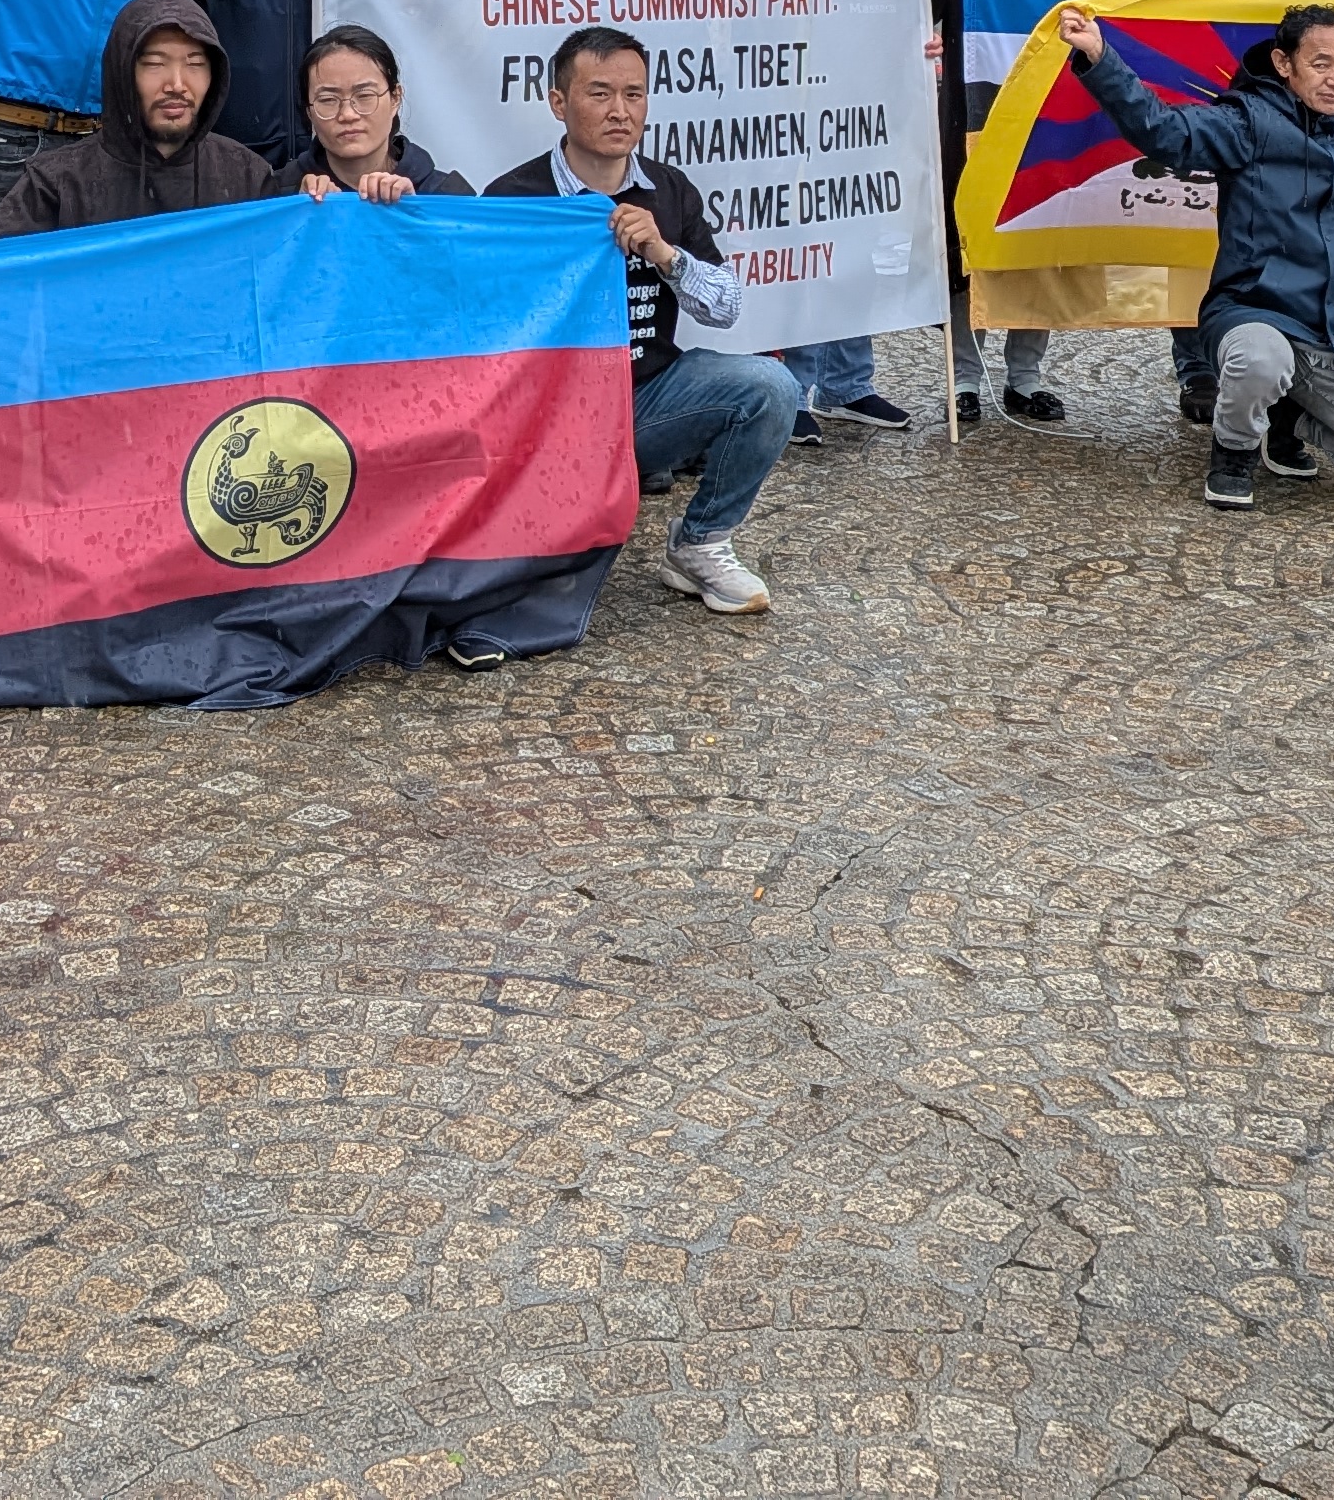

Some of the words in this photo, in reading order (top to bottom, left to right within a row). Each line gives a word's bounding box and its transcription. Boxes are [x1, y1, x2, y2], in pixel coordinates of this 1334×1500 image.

[647, 46, 725, 101] ASA,
[733, 41, 828, 90] TIBET...
[818, 103, 889, 153] CHINA
[707, 182, 791, 236] SAME
[798, 169, 901, 226] DEMAND
[727, 241, 835, 288] TABILITY
[627, 283, 661, 302] orget
